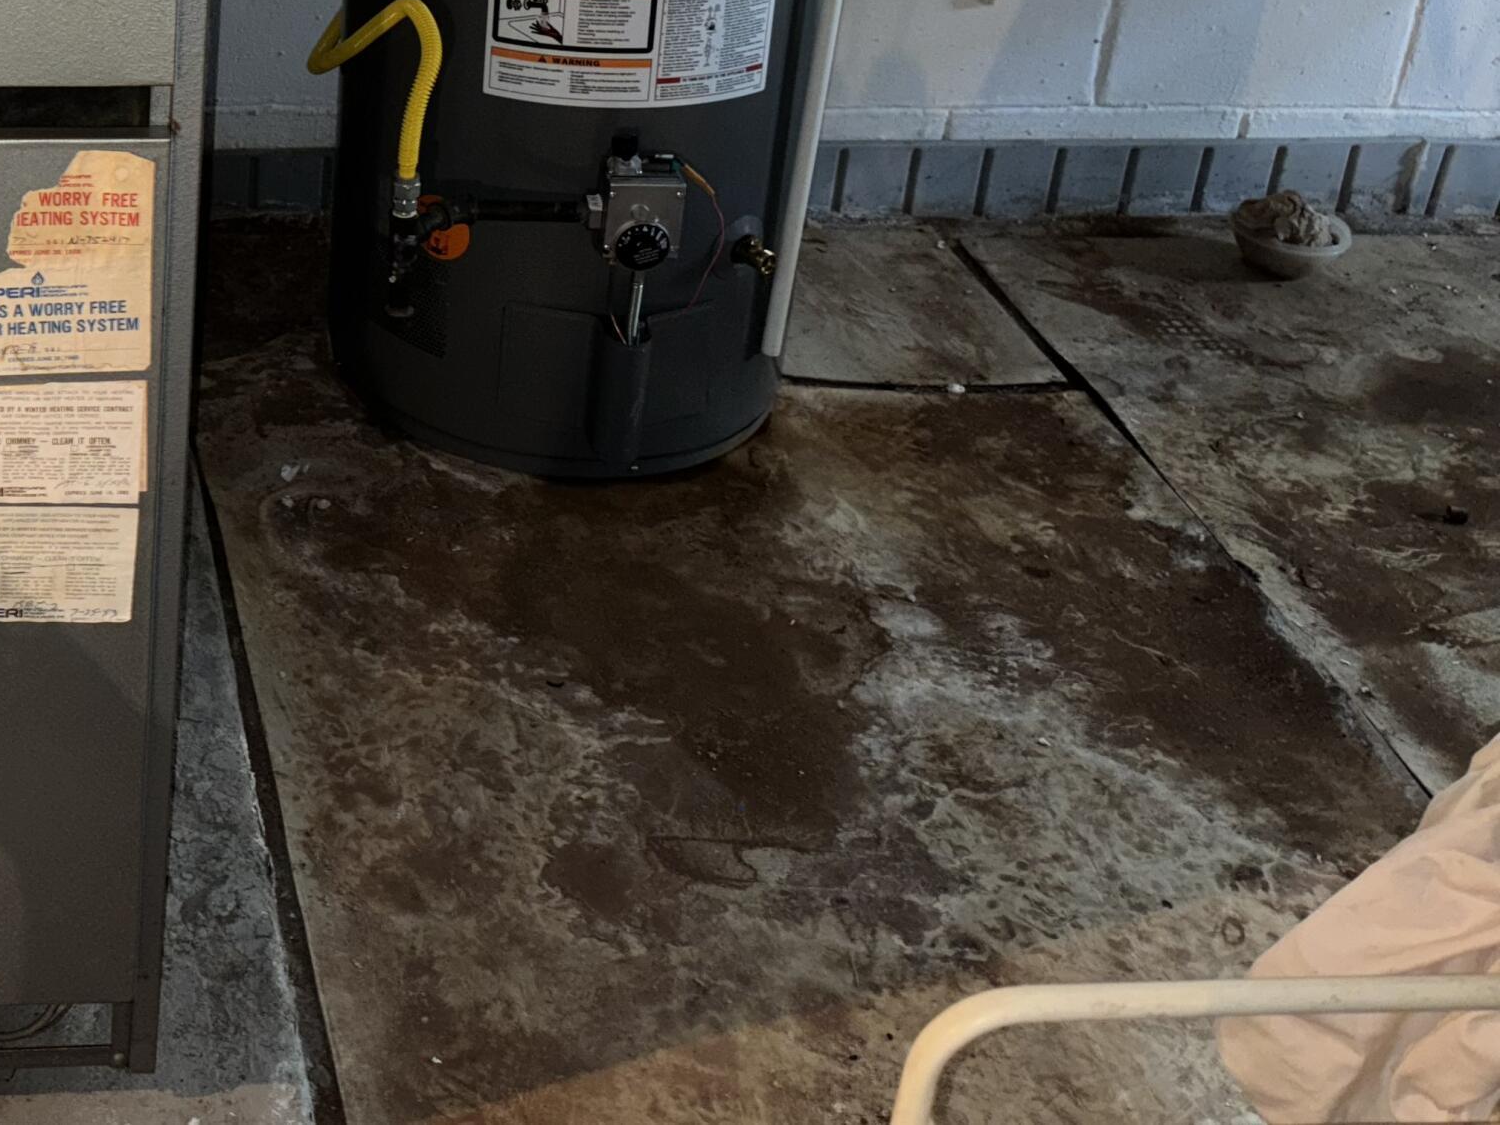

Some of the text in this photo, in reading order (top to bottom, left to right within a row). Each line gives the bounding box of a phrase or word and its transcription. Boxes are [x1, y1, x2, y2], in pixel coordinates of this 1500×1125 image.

[552, 57, 600, 67] WARNING
[39, 192, 139, 207] WORRY FREE
[80, 211, 140, 226] SYSTEM
[13, 304, 24, 317] A
[28, 302, 84, 317] WORRY
[90, 300, 127, 314] FREE
[7, 320, 72, 335] HEATING
[76, 318, 140, 333] SYSTEM
